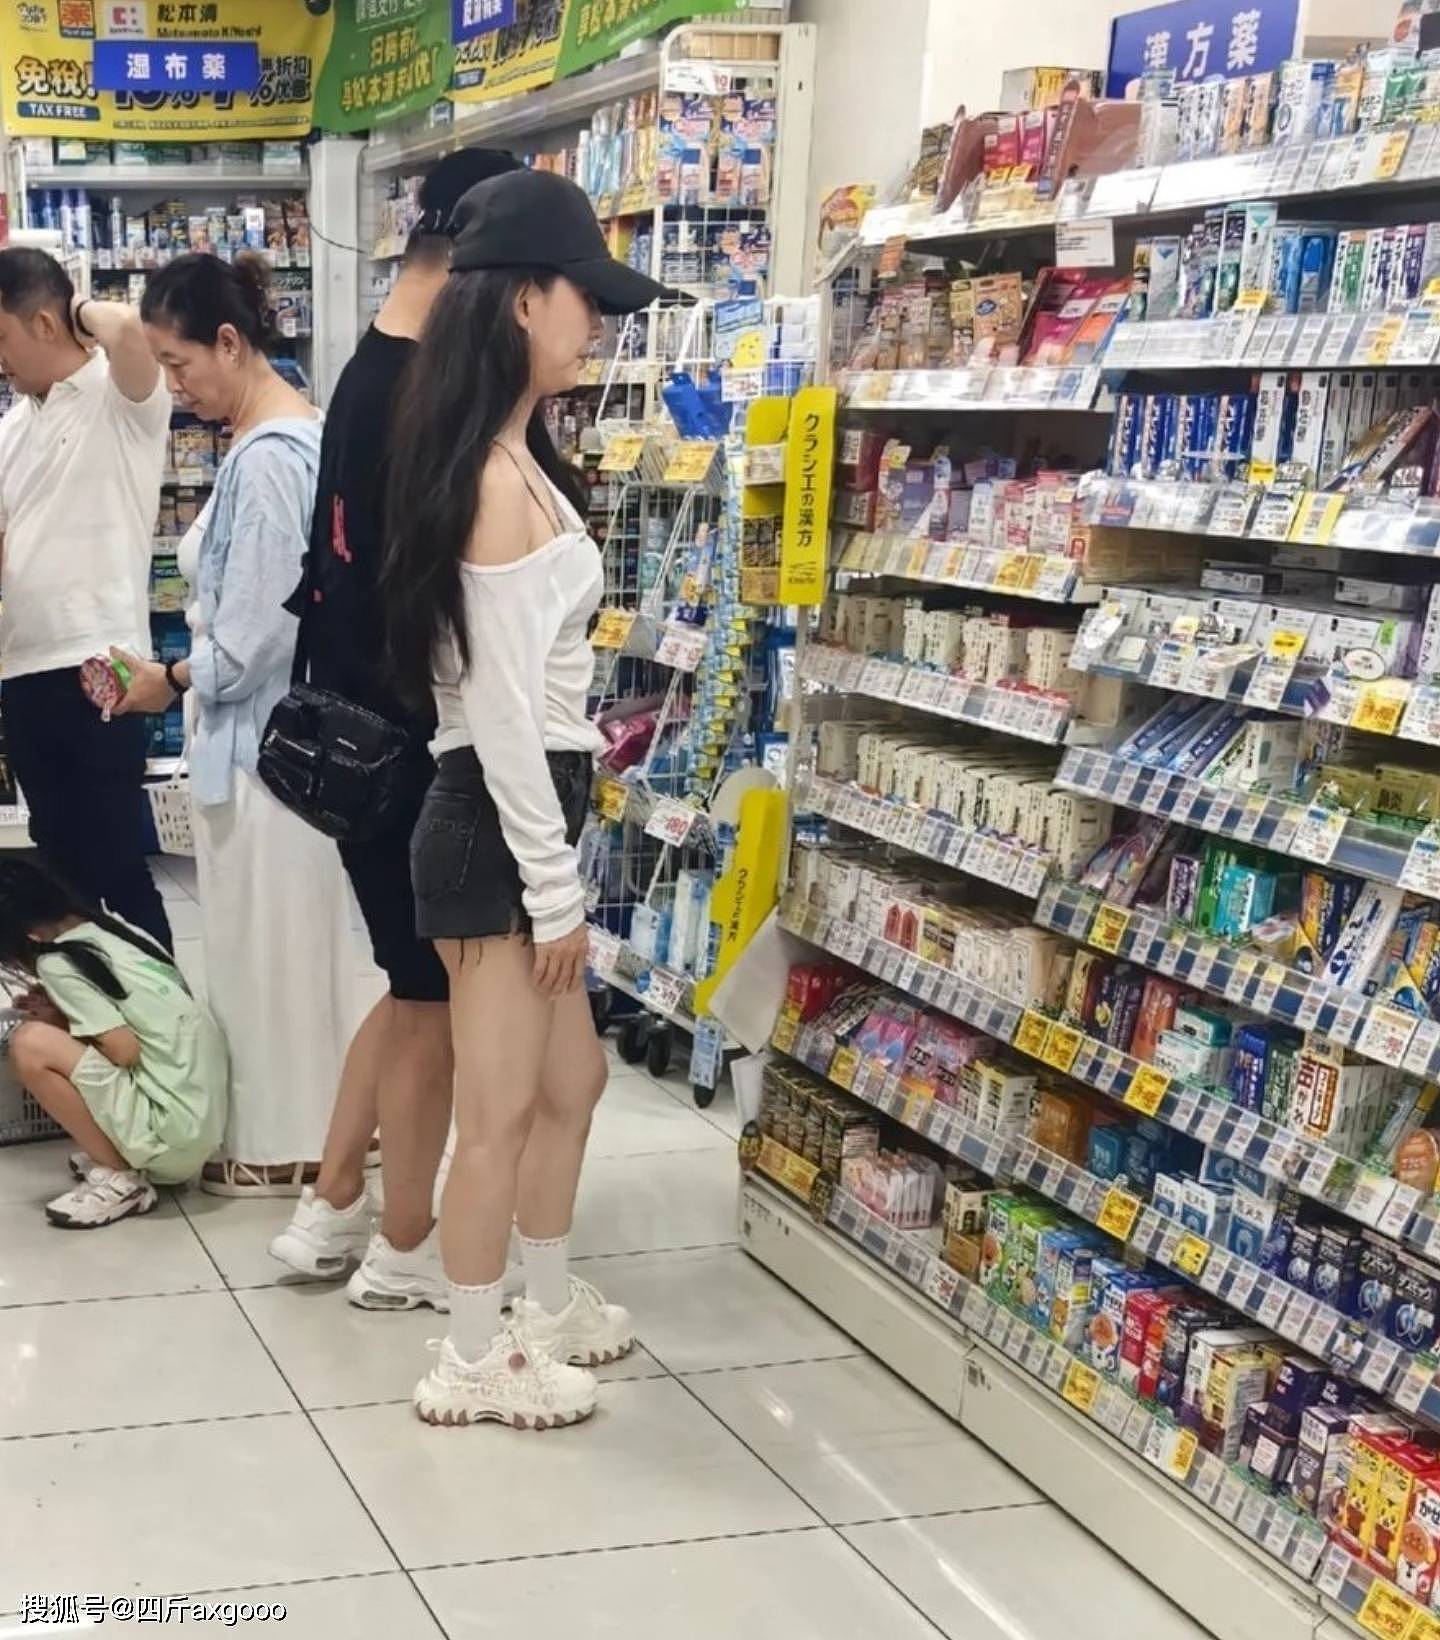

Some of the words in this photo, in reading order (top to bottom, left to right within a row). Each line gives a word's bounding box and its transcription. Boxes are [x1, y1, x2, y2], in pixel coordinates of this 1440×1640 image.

[157, 4, 218, 23] 松本清
[1144, 9, 1261, 78] 漢方薬
[126, 53, 226, 80] 湿布薬
[30, 103, 54, 117] TAX
[56, 105, 88, 118] FREE
[796, 413, 820, 548] クラシエの漢方
